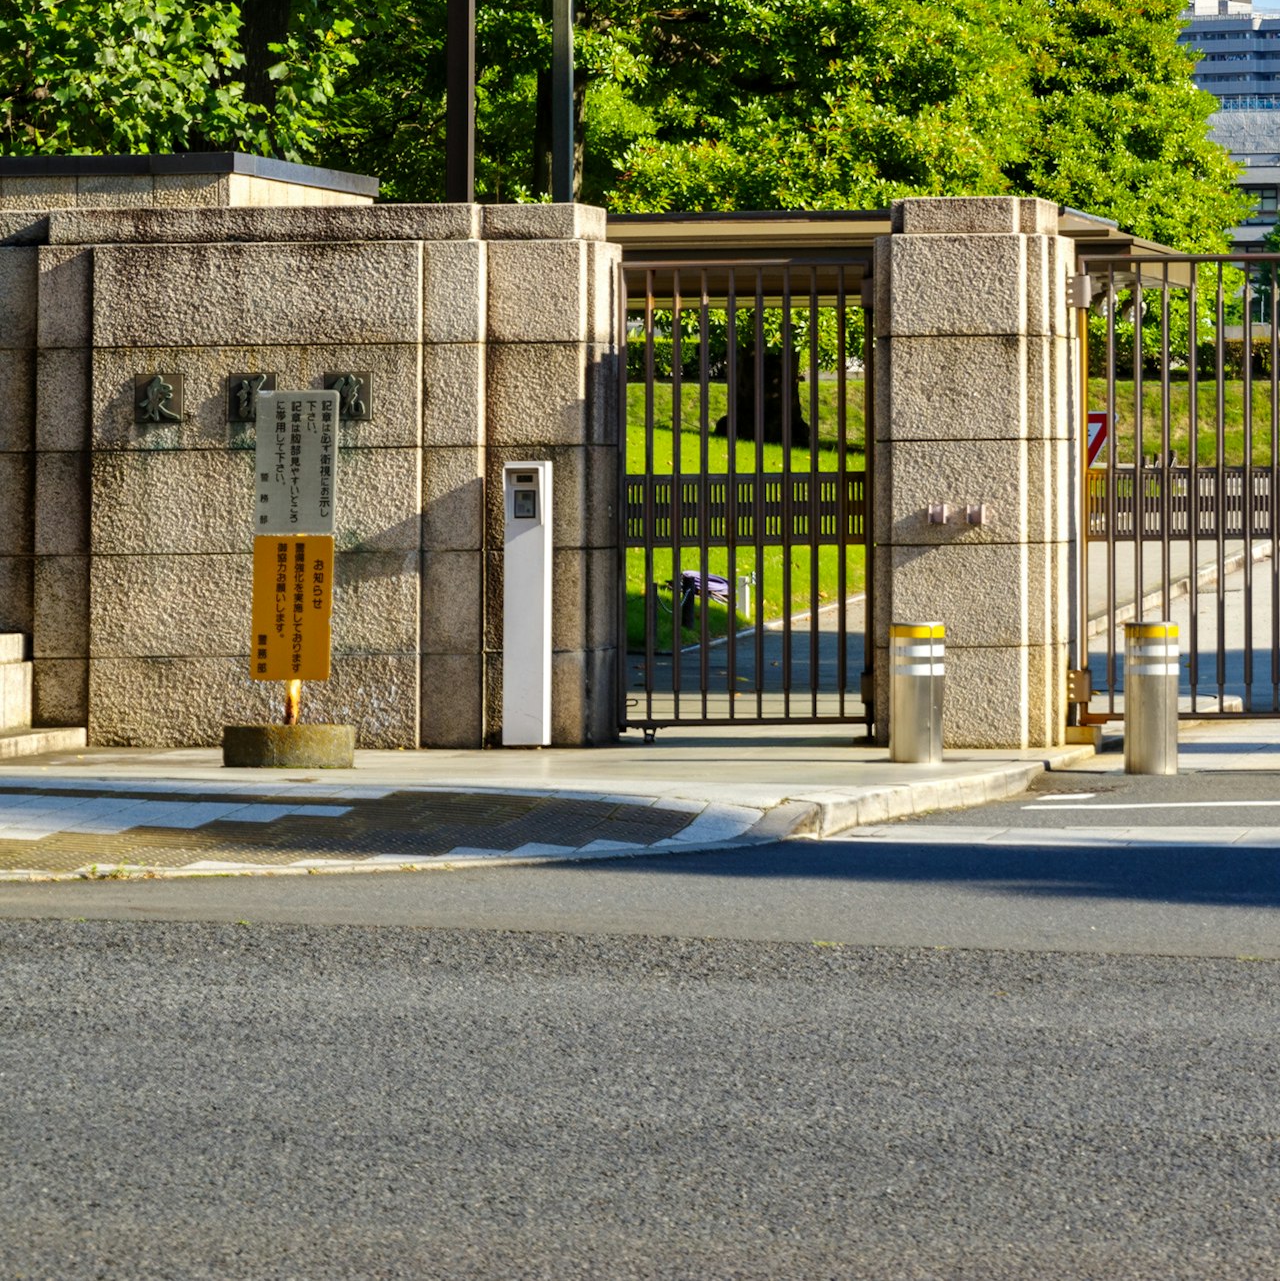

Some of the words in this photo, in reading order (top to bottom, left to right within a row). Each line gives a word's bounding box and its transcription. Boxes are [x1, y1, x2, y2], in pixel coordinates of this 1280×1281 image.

[289, 400, 302, 524] 記章は胸部見やすいところ
[305, 400, 318, 434] 下さい。
[319, 400, 333, 518] 記章は必ず衛視にお示し
[275, 542, 288, 639] 御協力お願いします。
[291, 542, 305, 674] 警備強化を実施しております
[312, 559, 324, 610] お知らせ
[257, 634, 267, 674] 警務部
